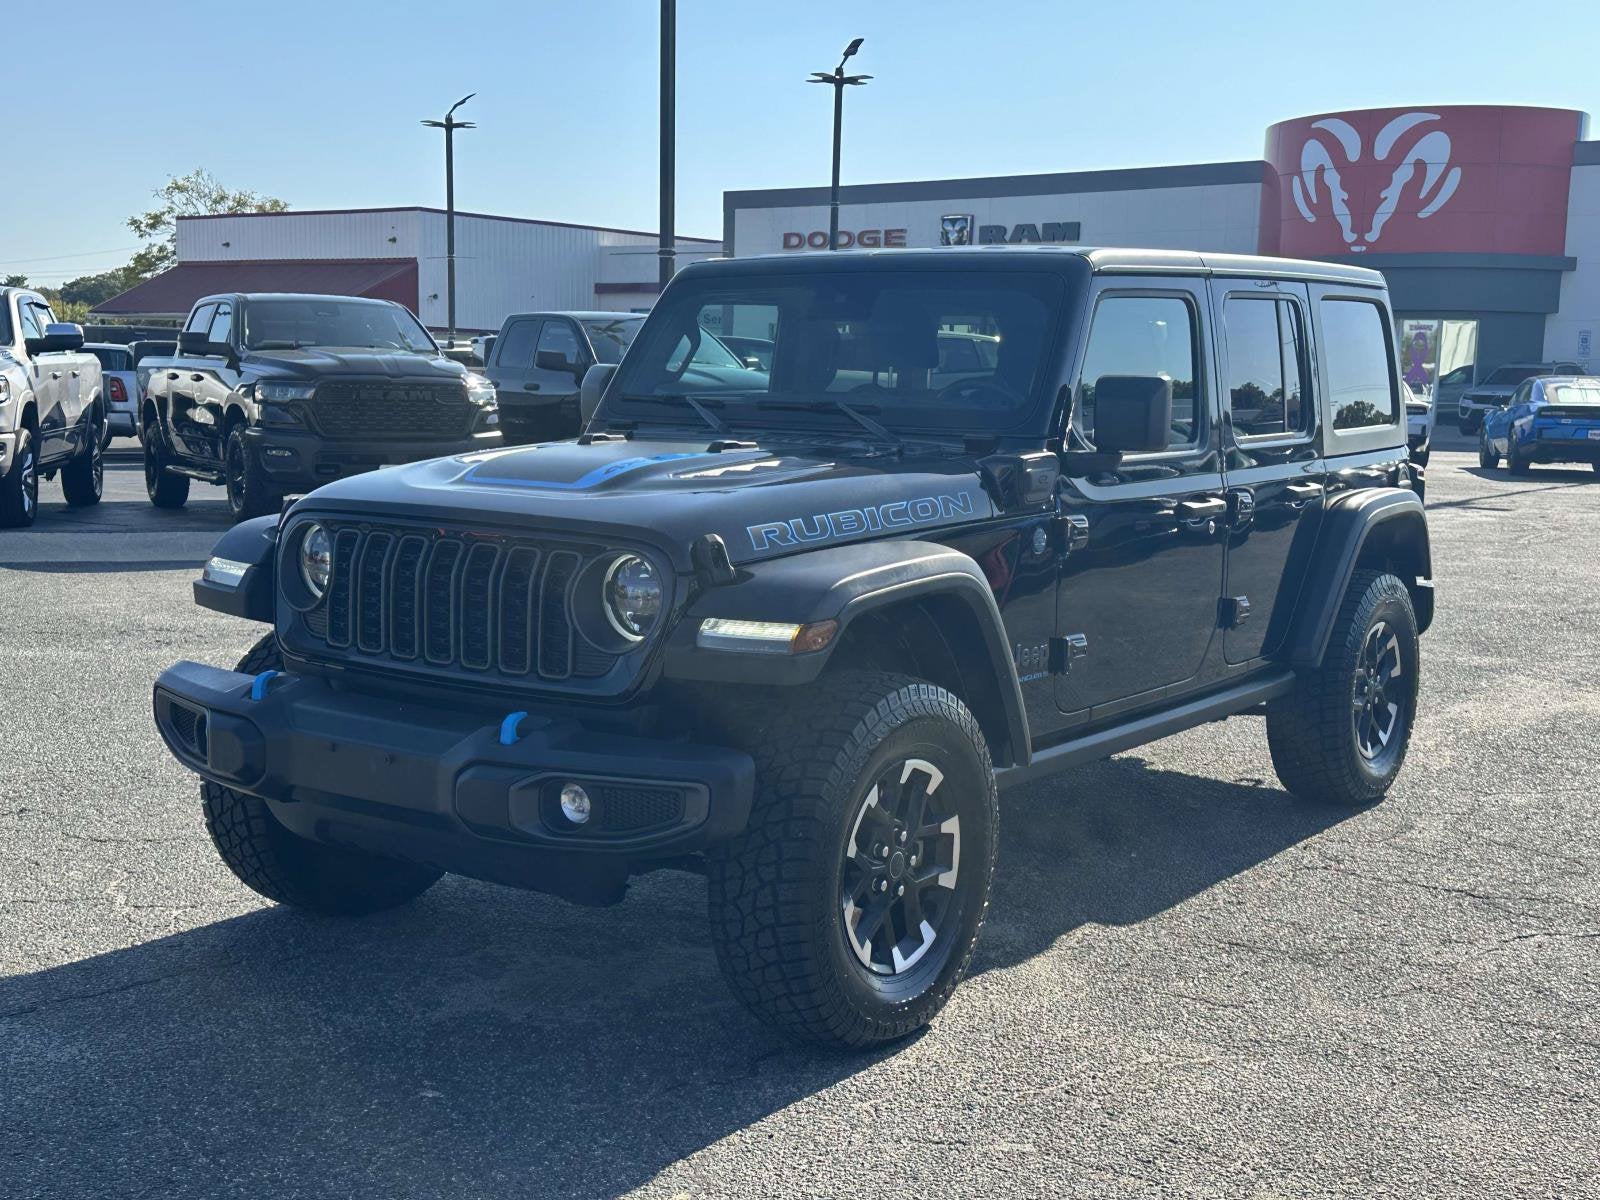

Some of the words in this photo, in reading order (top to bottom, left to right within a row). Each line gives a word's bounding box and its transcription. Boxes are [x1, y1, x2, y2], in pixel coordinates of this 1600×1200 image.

[783, 228, 907, 249] DODGE
[979, 222, 1081, 243] RAM
[359, 390, 433, 401] RAM
[746, 492, 973, 550] RUBICON
